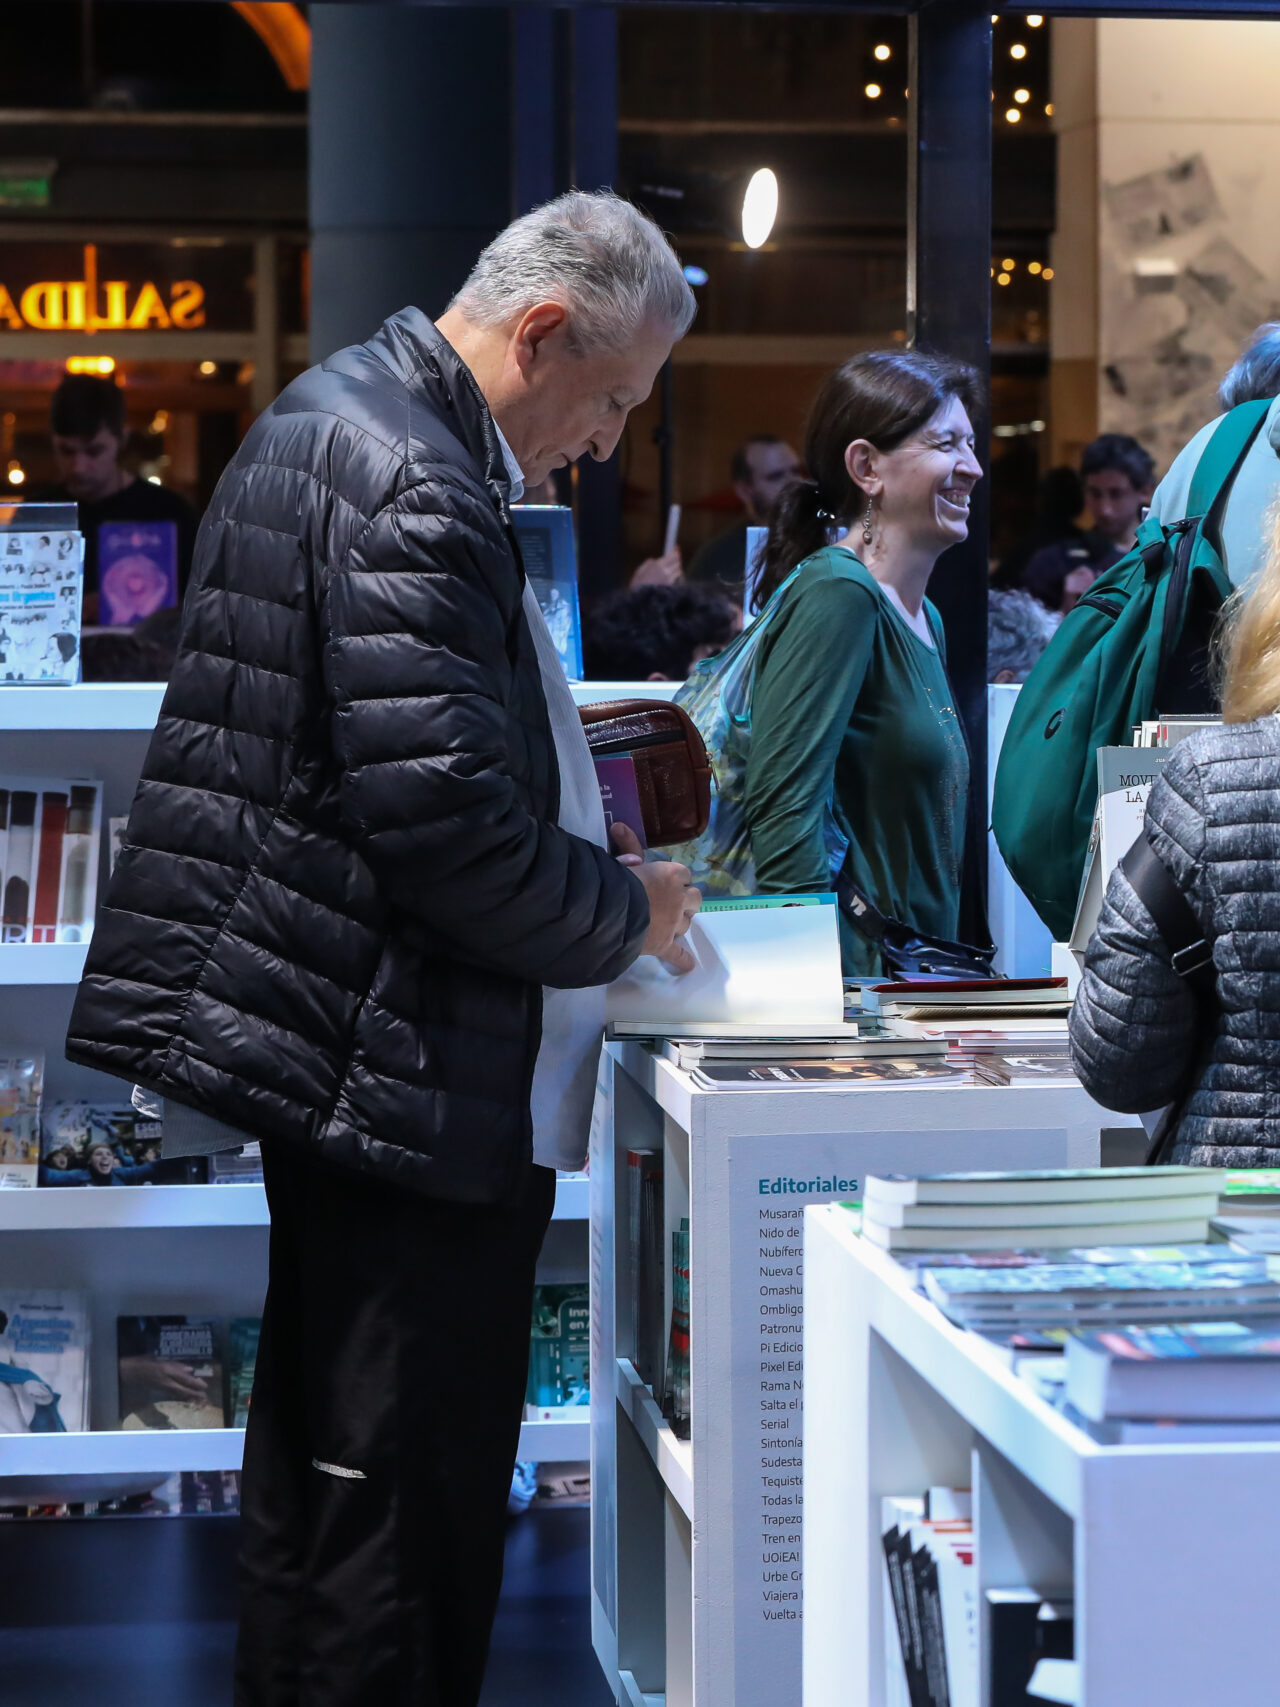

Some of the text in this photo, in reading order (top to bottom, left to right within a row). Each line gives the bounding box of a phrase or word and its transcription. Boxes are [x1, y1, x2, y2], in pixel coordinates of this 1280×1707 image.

[759, 1176, 858, 1194] Editoriales
[760, 1227, 799, 1238] Nido de
[760, 1267, 793, 1276] Nueva
[760, 1285, 803, 1296] Omashu
[760, 1304, 803, 1316] Ombligo
[760, 1343, 770, 1353] Pi
[760, 1362, 785, 1372] Pixel
[760, 1381, 790, 1391] Rama
[760, 1399, 798, 1410] Salta el
[760, 1419, 789, 1429] Serial
[761, 1437, 803, 1448] Sintonía
[761, 1457, 803, 1467] Sudesta
[761, 1495, 792, 1505] Todas
[762, 1514, 803, 1526] Trapezo
[762, 1533, 801, 1544] Tren en
[762, 1571, 788, 1582] Urbe
[762, 1590, 798, 1603] Viajera
[762, 1609, 796, 1620] Vuelta
